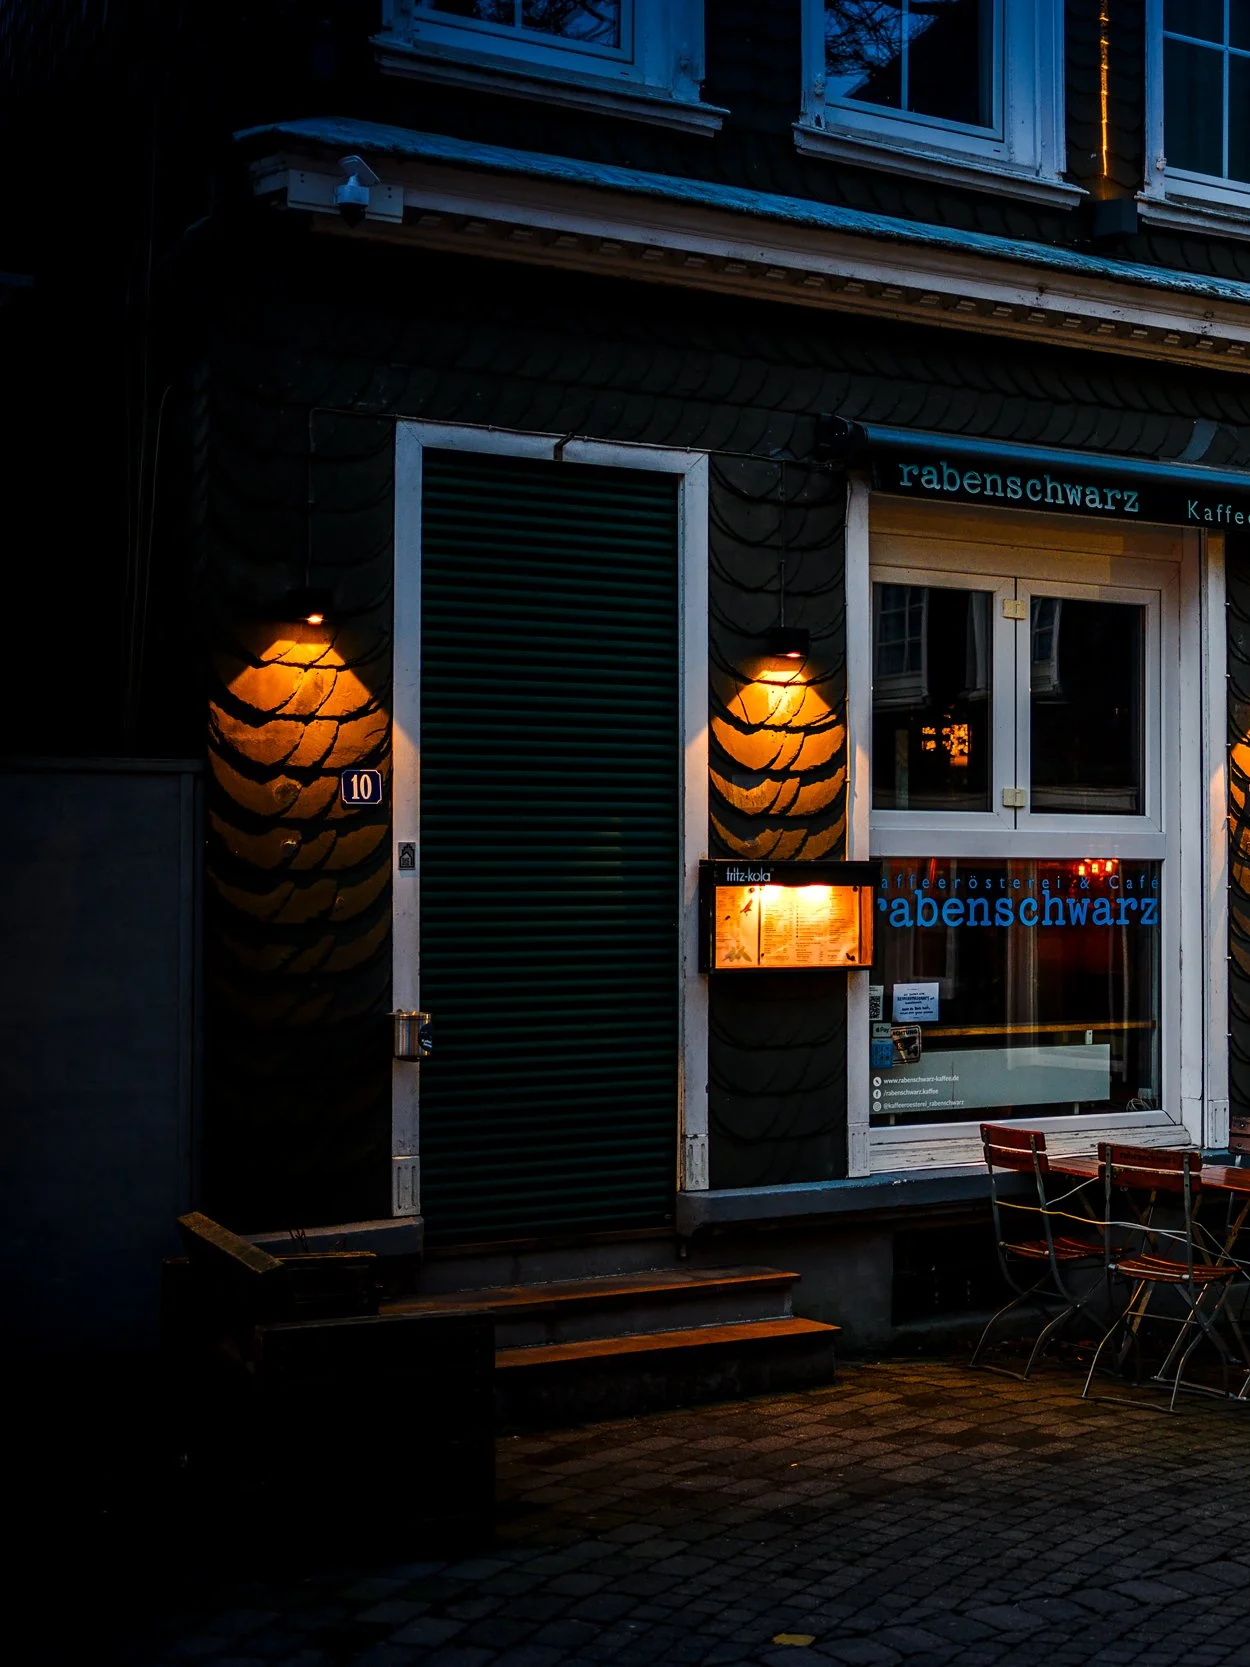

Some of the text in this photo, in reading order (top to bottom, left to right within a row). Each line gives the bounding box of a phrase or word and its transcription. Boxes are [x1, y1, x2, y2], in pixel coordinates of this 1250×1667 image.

[899, 459, 1140, 514] rabenschwarz
[351, 774, 372, 799] 10
[726, 866, 771, 882] fritz-kola
[880, 873, 1160, 889] affeerösterei & Café
[883, 1075, 959, 1084] www.rabenschwarz-kaffee.de
